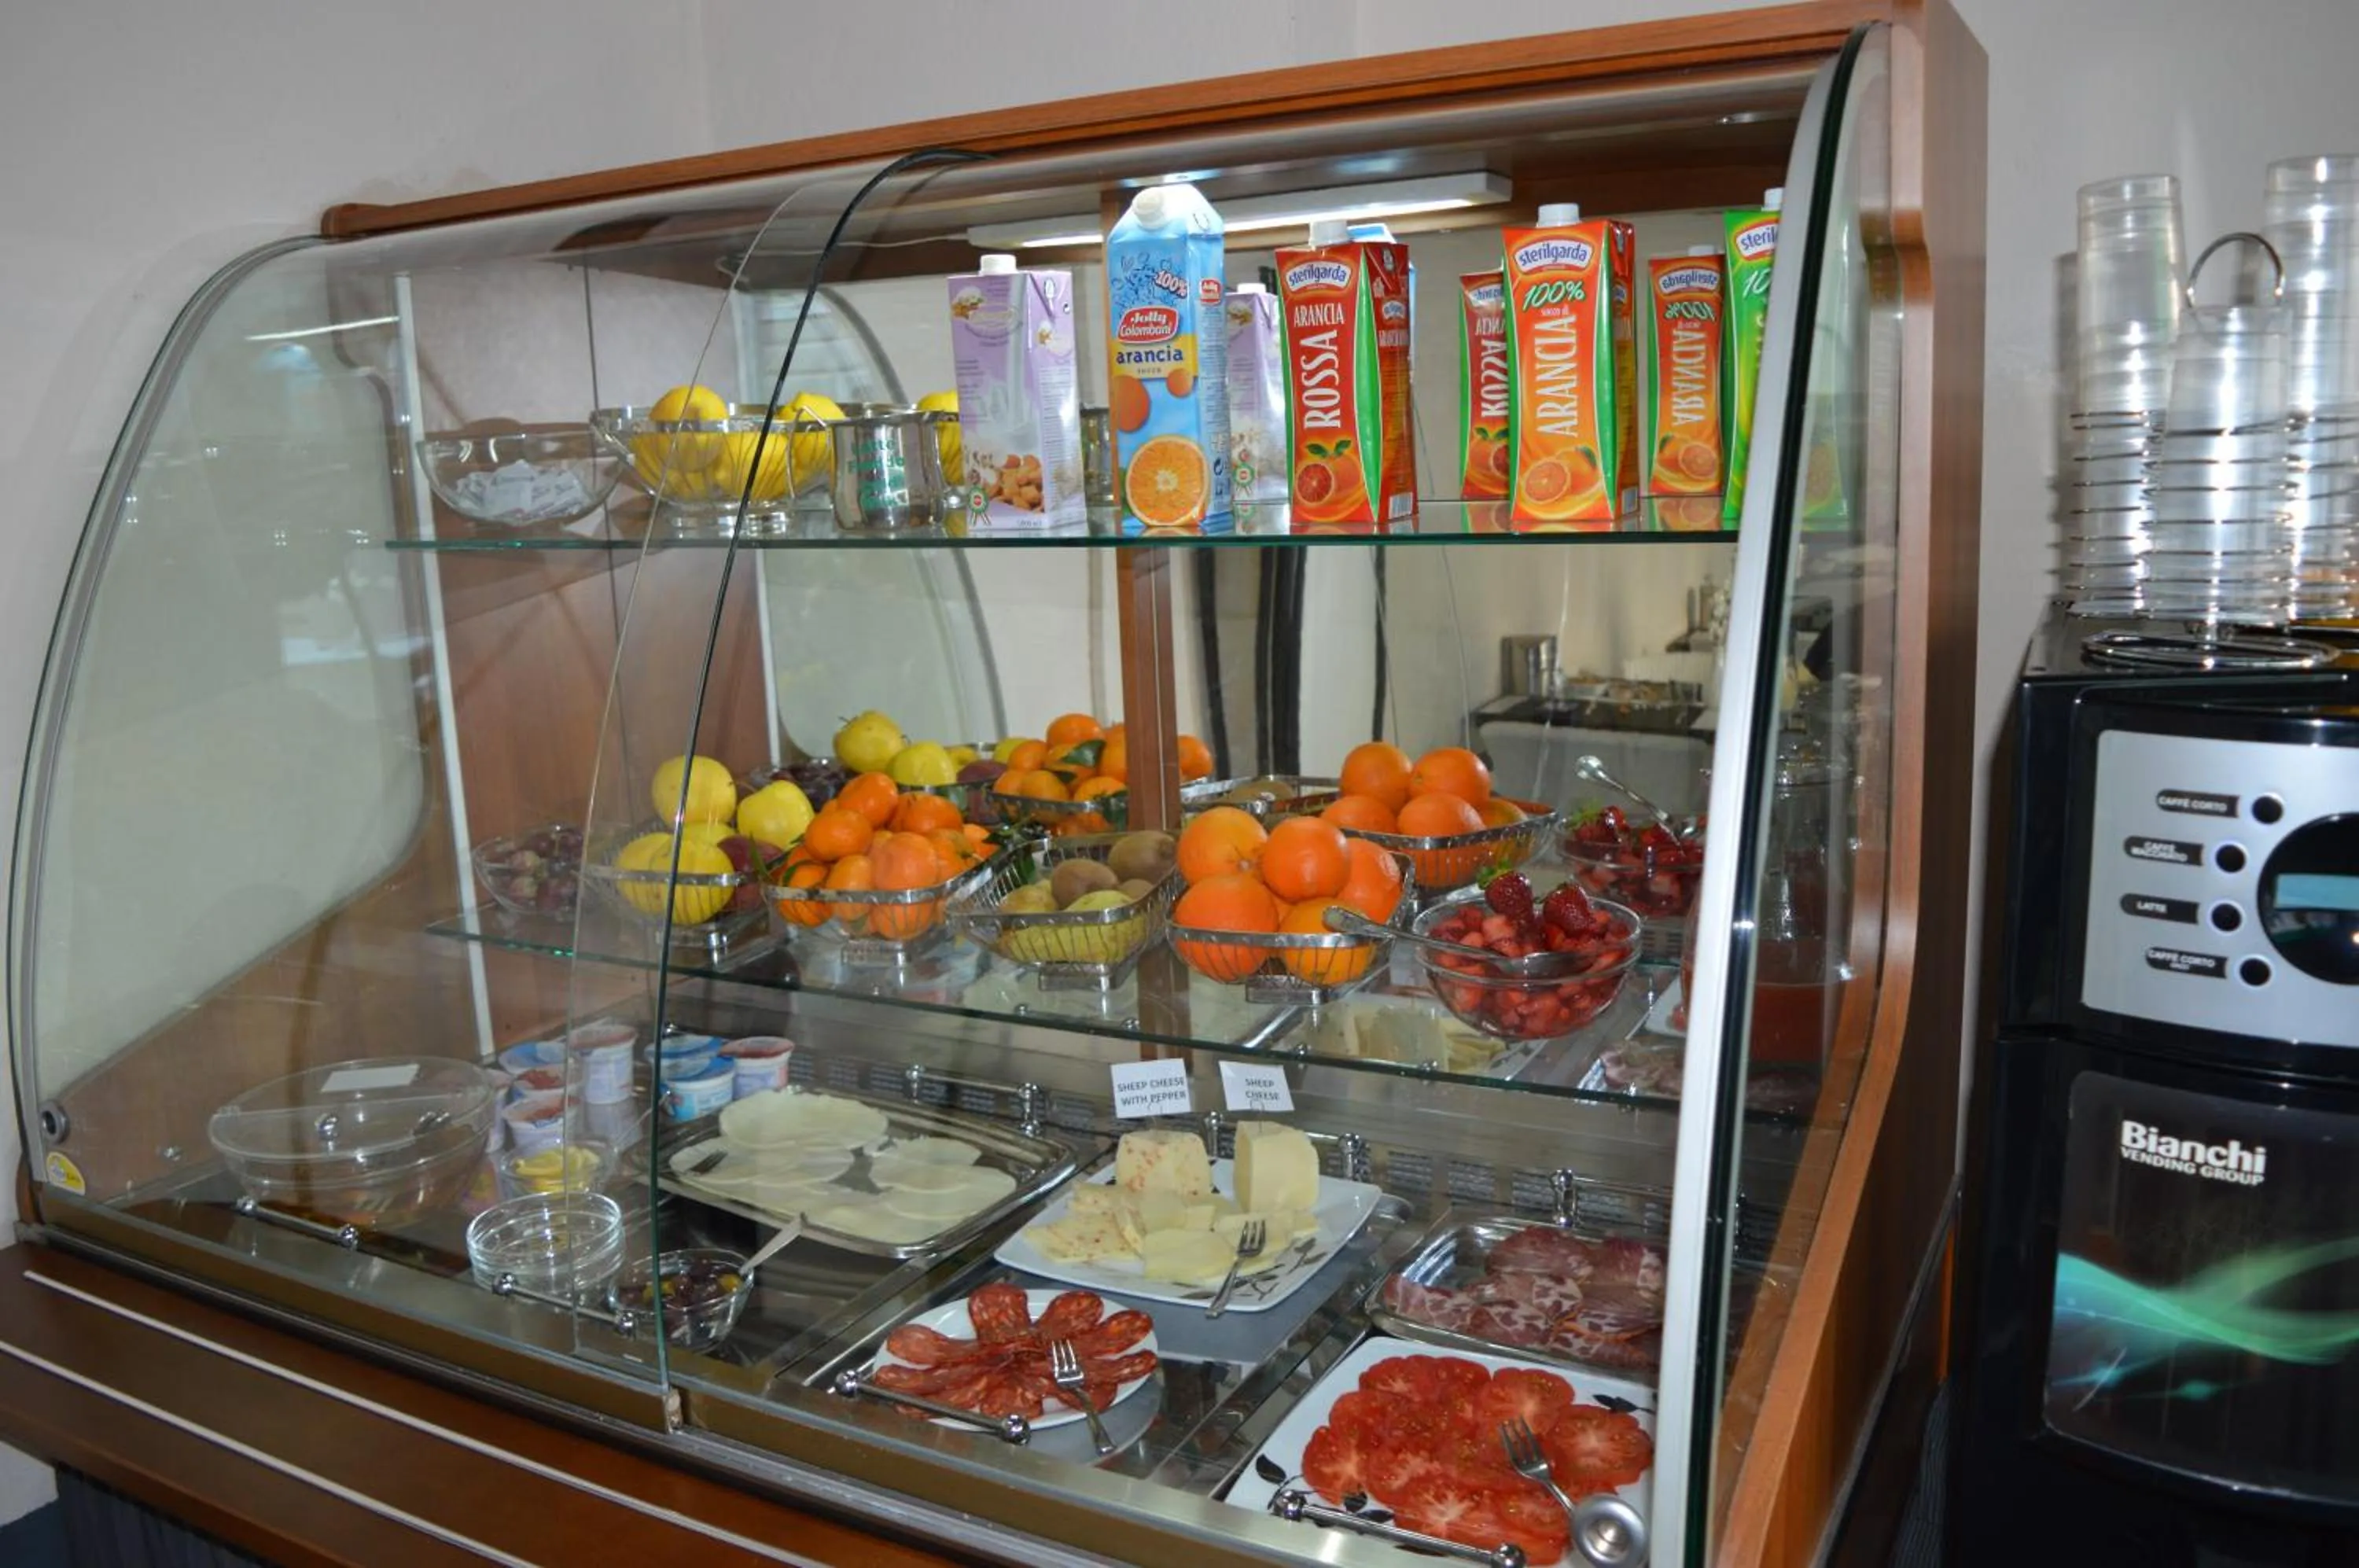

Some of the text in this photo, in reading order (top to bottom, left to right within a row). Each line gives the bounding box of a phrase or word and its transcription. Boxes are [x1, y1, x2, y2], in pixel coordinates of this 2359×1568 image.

[1740, 225, 1779, 252] steril
[1519, 243, 1588, 267] sterilgarda
[1154, 271, 1188, 297] 100%
[1289, 264, 1346, 286] sterilgarda
[1743, 269, 1772, 297] 10
[1523, 280, 1585, 311] 100%
[1131, 311, 1167, 326] Jolly
[1294, 302, 1345, 327] ARANCIA
[1116, 345, 1183, 364] arancia
[1299, 329, 1341, 429] ROSSA
[1535, 314, 1578, 437] ARANCIA
[2192, 800, 2228, 813] CORTO
[1117, 1077, 1185, 1093] SHEEP CHEESE
[1245, 1078, 1275, 1088] SHEEP
[1121, 1091, 1187, 1106] WITH PEPPER
[1245, 1090, 1280, 1101] CHEESE
[2121, 1119, 2266, 1174] Bianchi
[2120, 1146, 2265, 1186] VENDING GROUP
